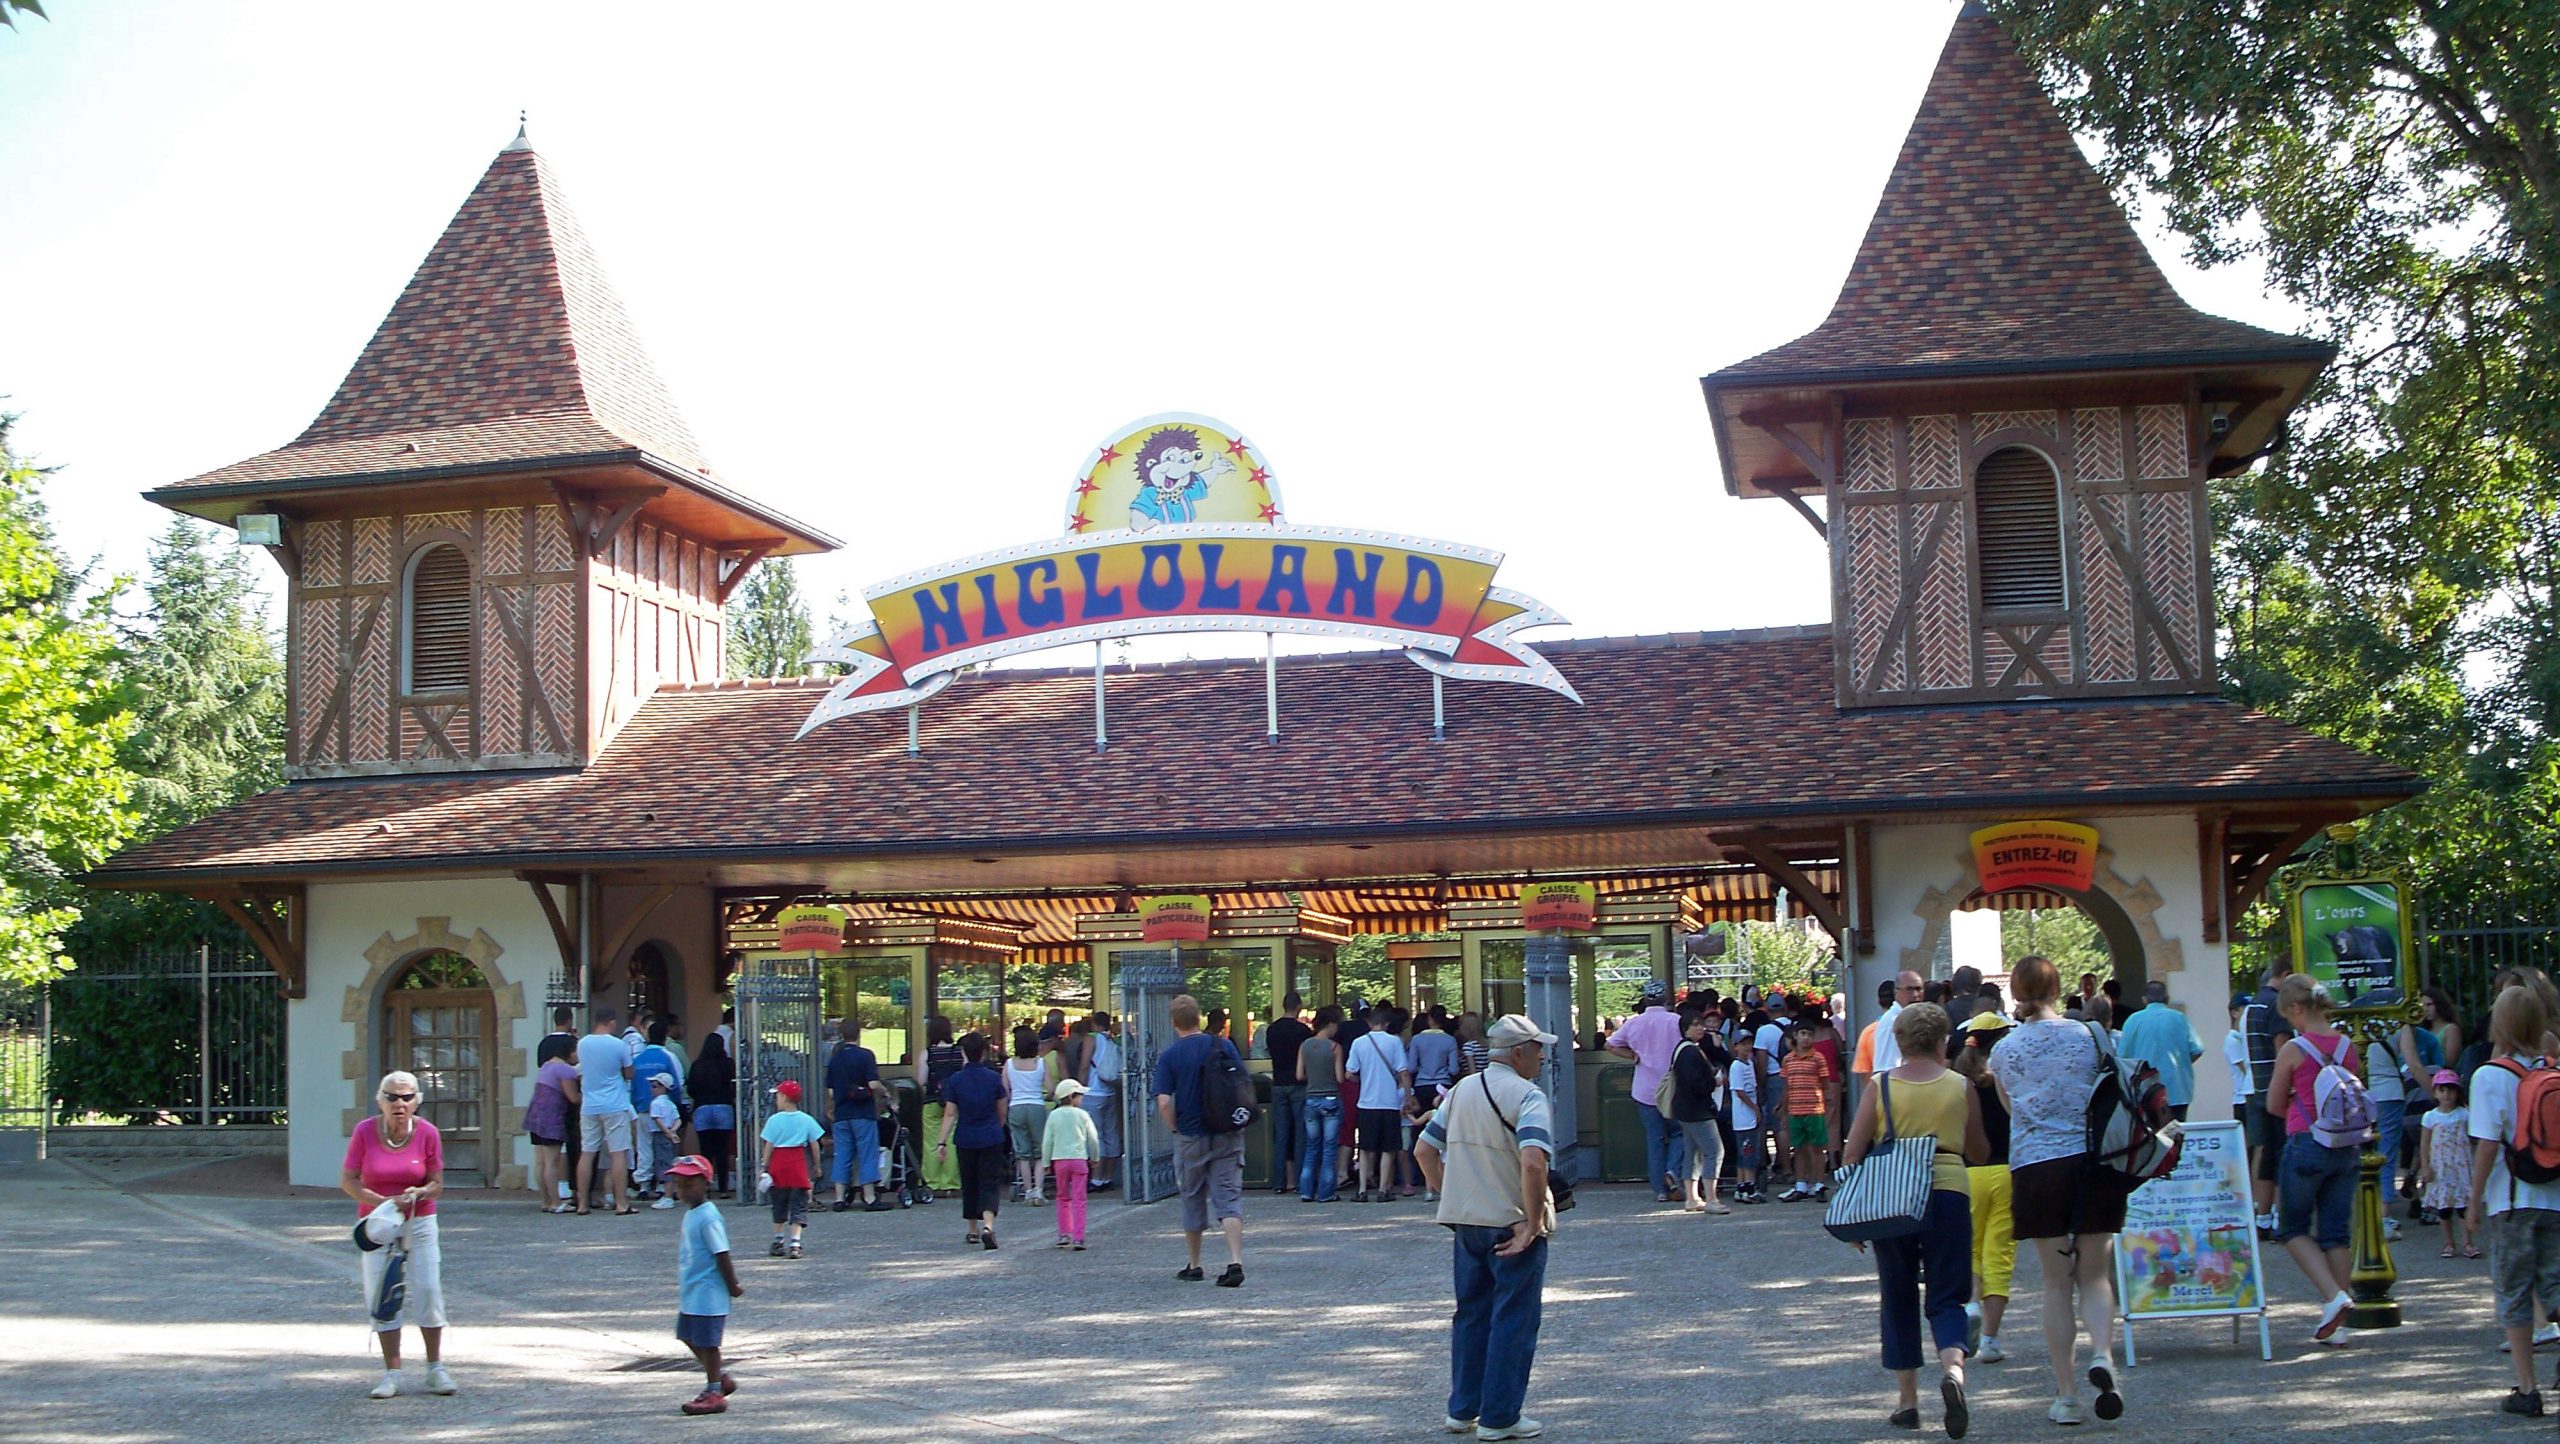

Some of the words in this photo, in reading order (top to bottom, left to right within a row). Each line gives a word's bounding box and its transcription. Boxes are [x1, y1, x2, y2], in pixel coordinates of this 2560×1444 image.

[912, 543, 1444, 654] NIGLOLAND
[1992, 847, 2078, 866] ENTREZ-ICI
[1540, 885, 1577, 894] CAISSE
[1536, 894, 1581, 905] GROUPES
[1158, 902, 1194, 911] CAISSE
[796, 914, 830, 923] CAISSE
[1146, 914, 1206, 926] PARTICULIERS
[1528, 912, 1590, 924] PARTICULIERS
[783, 925, 840, 936] PARTICULIERS
[2185, 1137, 2222, 1152] PES
[2172, 1284, 2214, 1297] Merci
